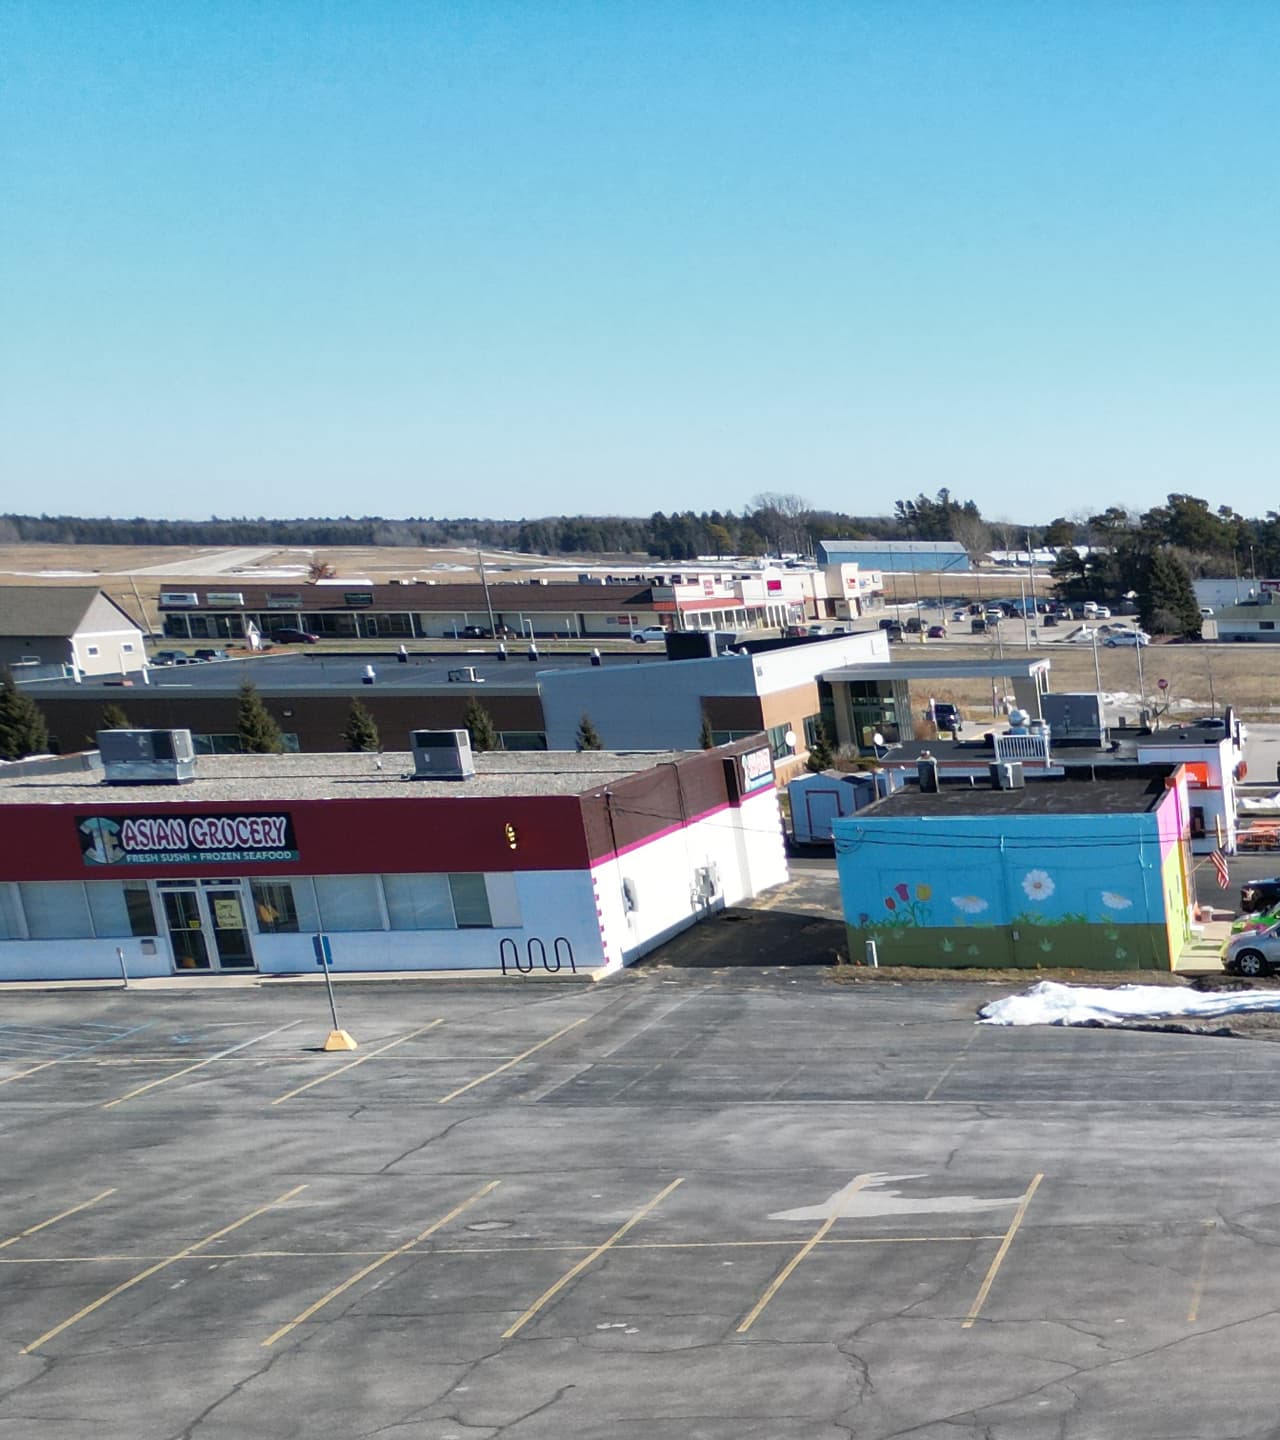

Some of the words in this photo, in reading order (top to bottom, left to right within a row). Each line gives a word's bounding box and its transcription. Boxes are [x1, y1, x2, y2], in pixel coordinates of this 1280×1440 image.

[121, 818, 188, 850] ASIAN
[188, 816, 287, 849] GROCERY
[126, 854, 159, 863] FRESH
[160, 853, 191, 862] SUSHI
[200, 852, 241, 861] FROZEN
[243, 851, 292, 860] SEAFOOD
